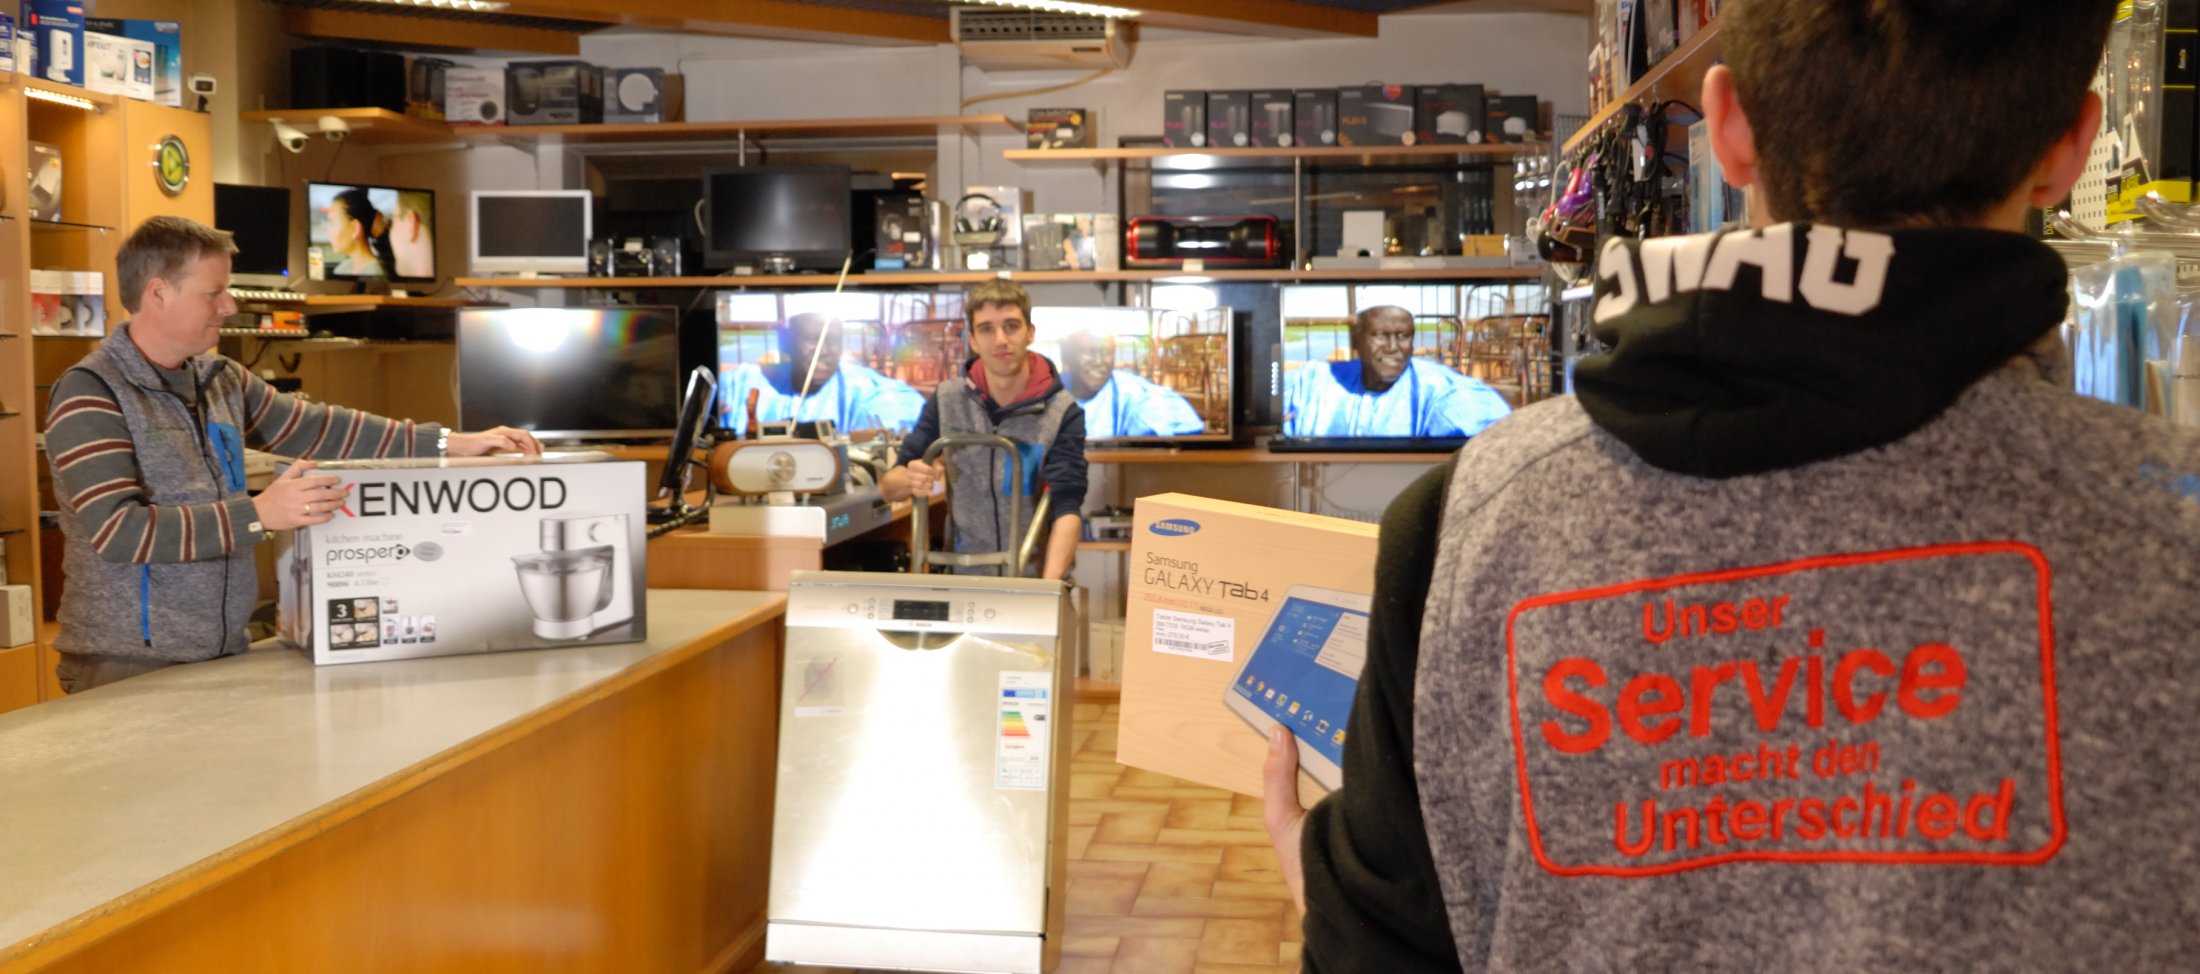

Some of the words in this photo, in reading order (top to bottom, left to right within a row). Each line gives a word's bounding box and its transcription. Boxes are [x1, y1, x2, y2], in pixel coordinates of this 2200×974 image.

[325, 533, 360, 544] kitchen
[363, 532, 404, 543] machine
[1154, 520, 1195, 533] SAMSUNG
[1145, 551, 1199, 575] Samsung
[1144, 567, 1214, 595] GALAXY
[336, 603, 348, 618] 3
[1642, 594, 1791, 645] Unser
[1540, 628, 1968, 755] Service
[1660, 741, 1800, 790] macht
[1812, 738, 1880, 779] den
[1614, 778, 2016, 858] Unterschied
